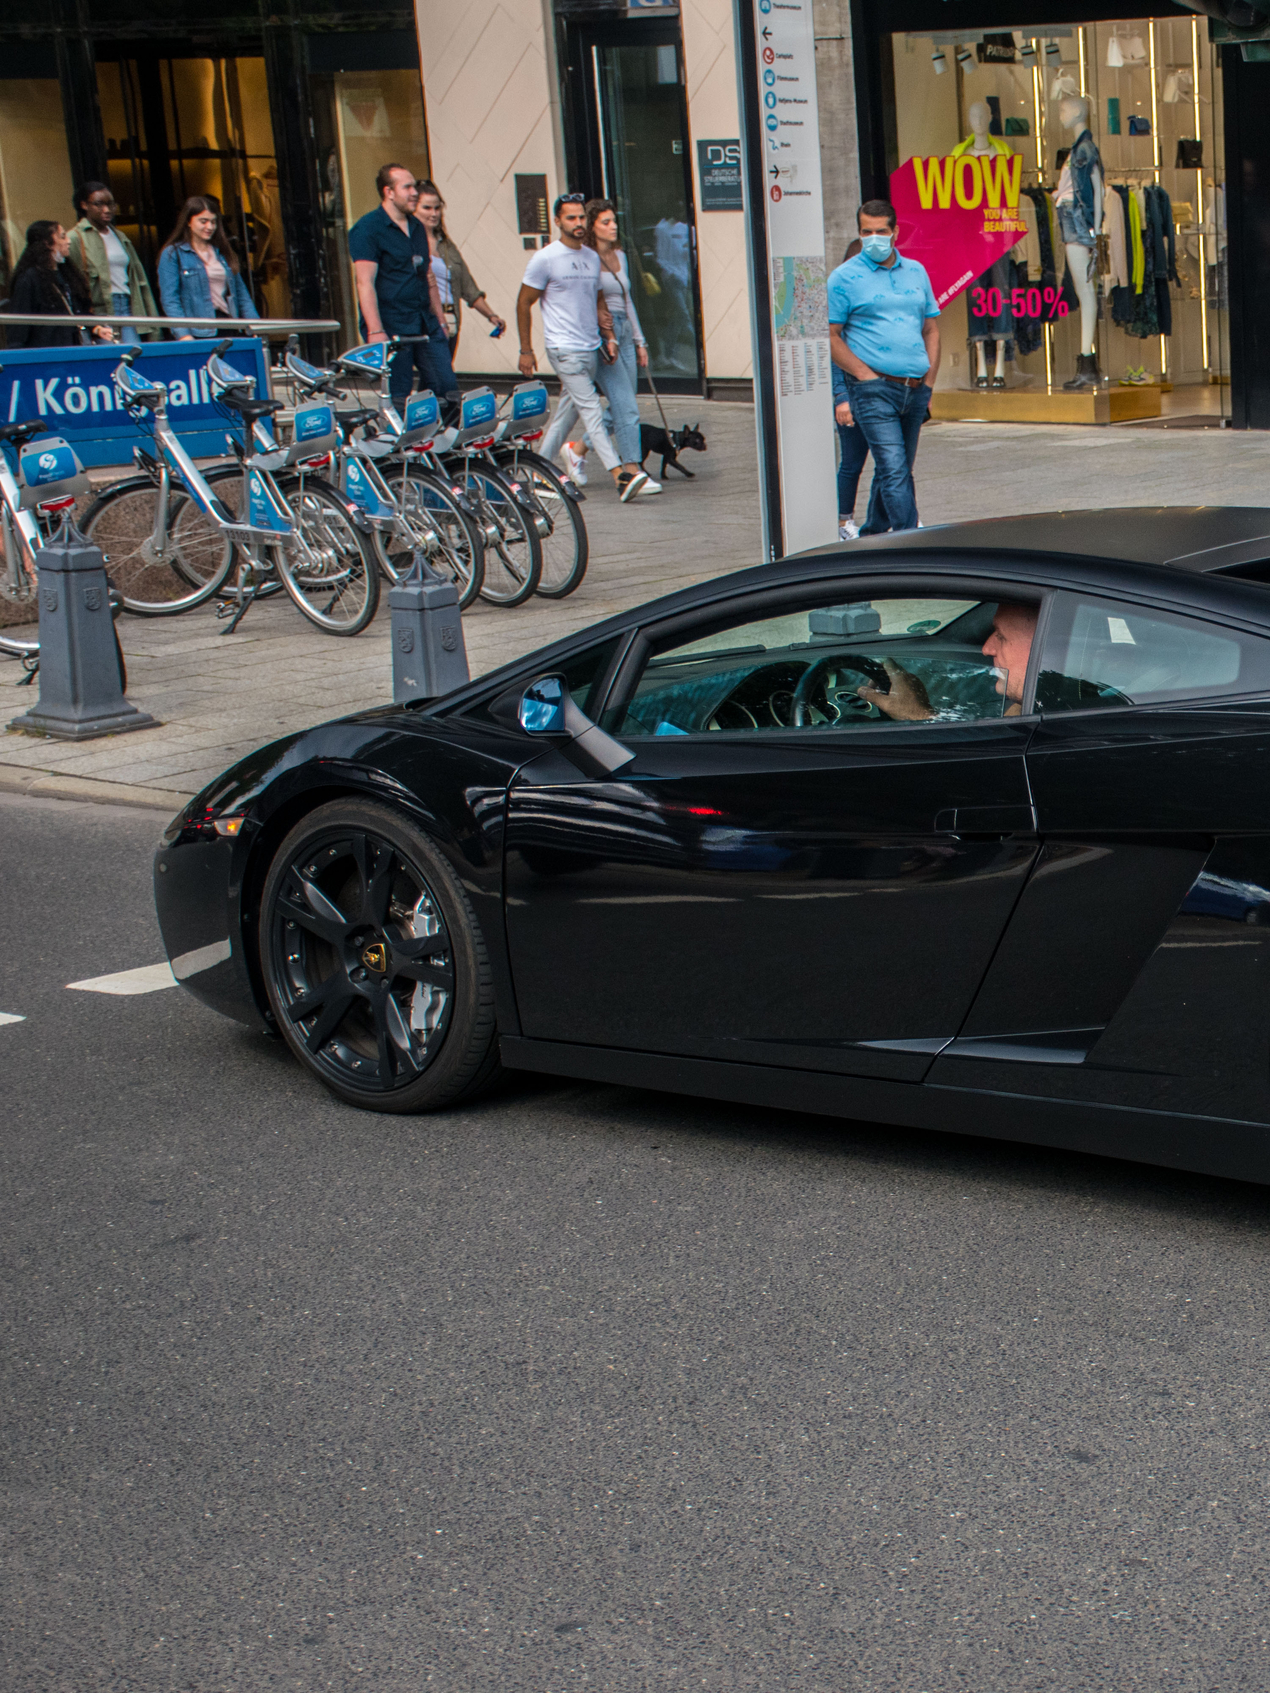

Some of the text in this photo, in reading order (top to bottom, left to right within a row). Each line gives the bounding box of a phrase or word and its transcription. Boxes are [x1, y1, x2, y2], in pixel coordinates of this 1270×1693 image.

[912, 153, 1024, 210] WOW
[982, 208, 1019, 220] YOU ARE
[983, 220, 1029, 232] BEAUTIFUL
[971, 286, 1069, 319] 30-50%
